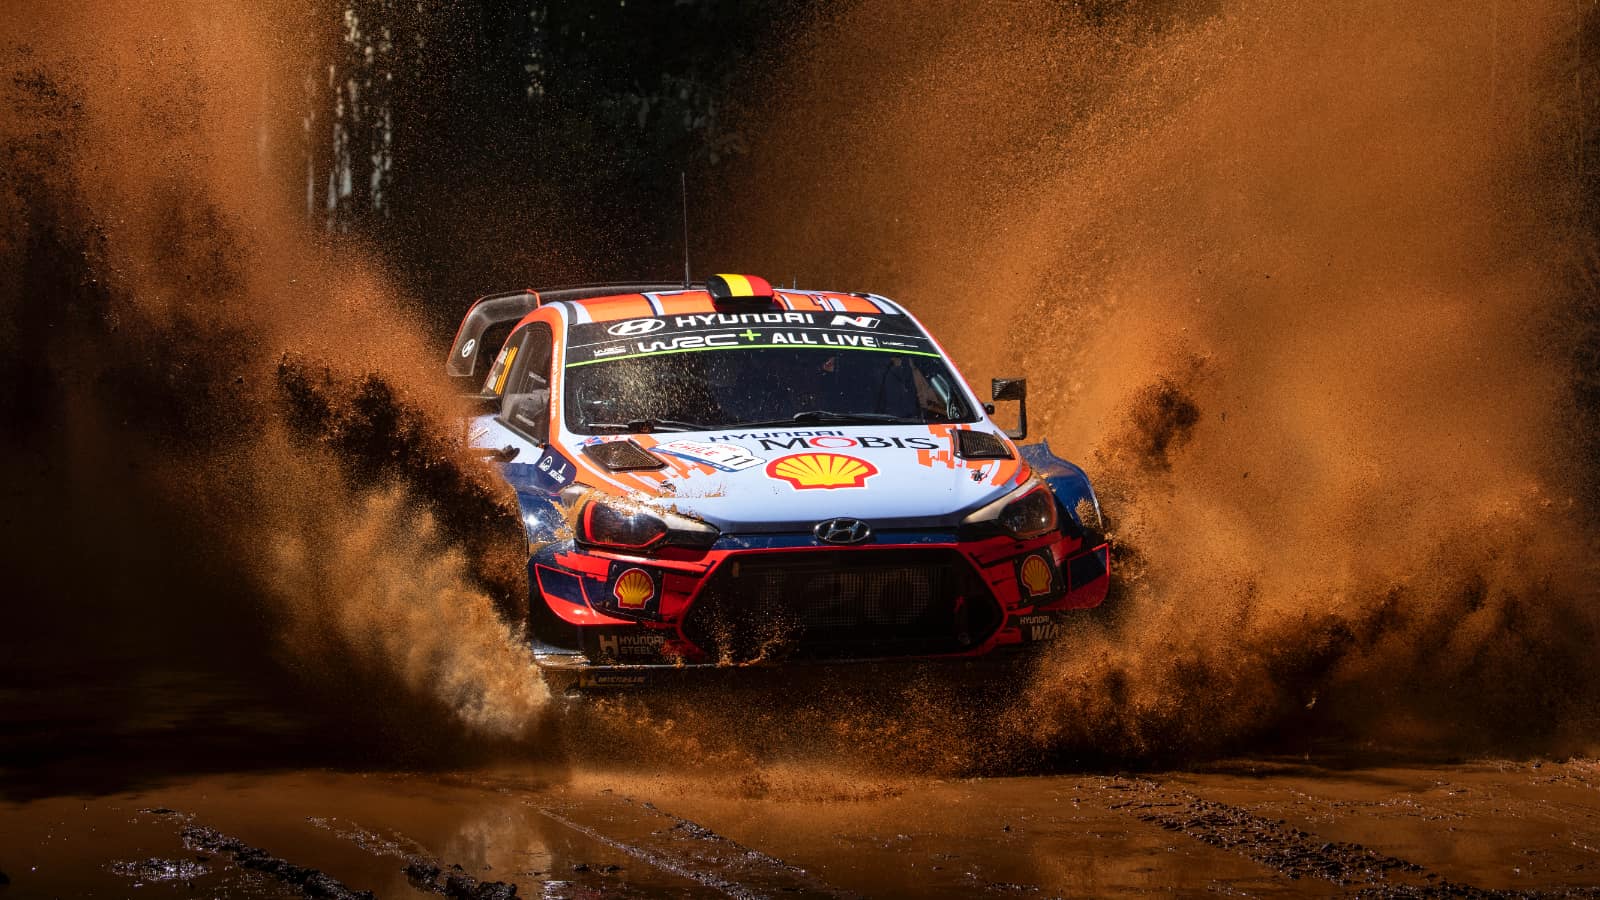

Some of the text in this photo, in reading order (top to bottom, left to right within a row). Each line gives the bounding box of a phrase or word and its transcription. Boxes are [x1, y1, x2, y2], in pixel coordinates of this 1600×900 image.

[674, 312, 816, 328] HYUNDAI
[771, 332, 817, 345] ALL
[822, 333, 877, 348] LIVE
[709, 430, 845, 442] HYUNDAI
[760, 436, 940, 451] MOBIS
[721, 454, 755, 467] 11
[620, 634, 665, 645] HYUNDAI
[621, 646, 654, 656] STEEL
